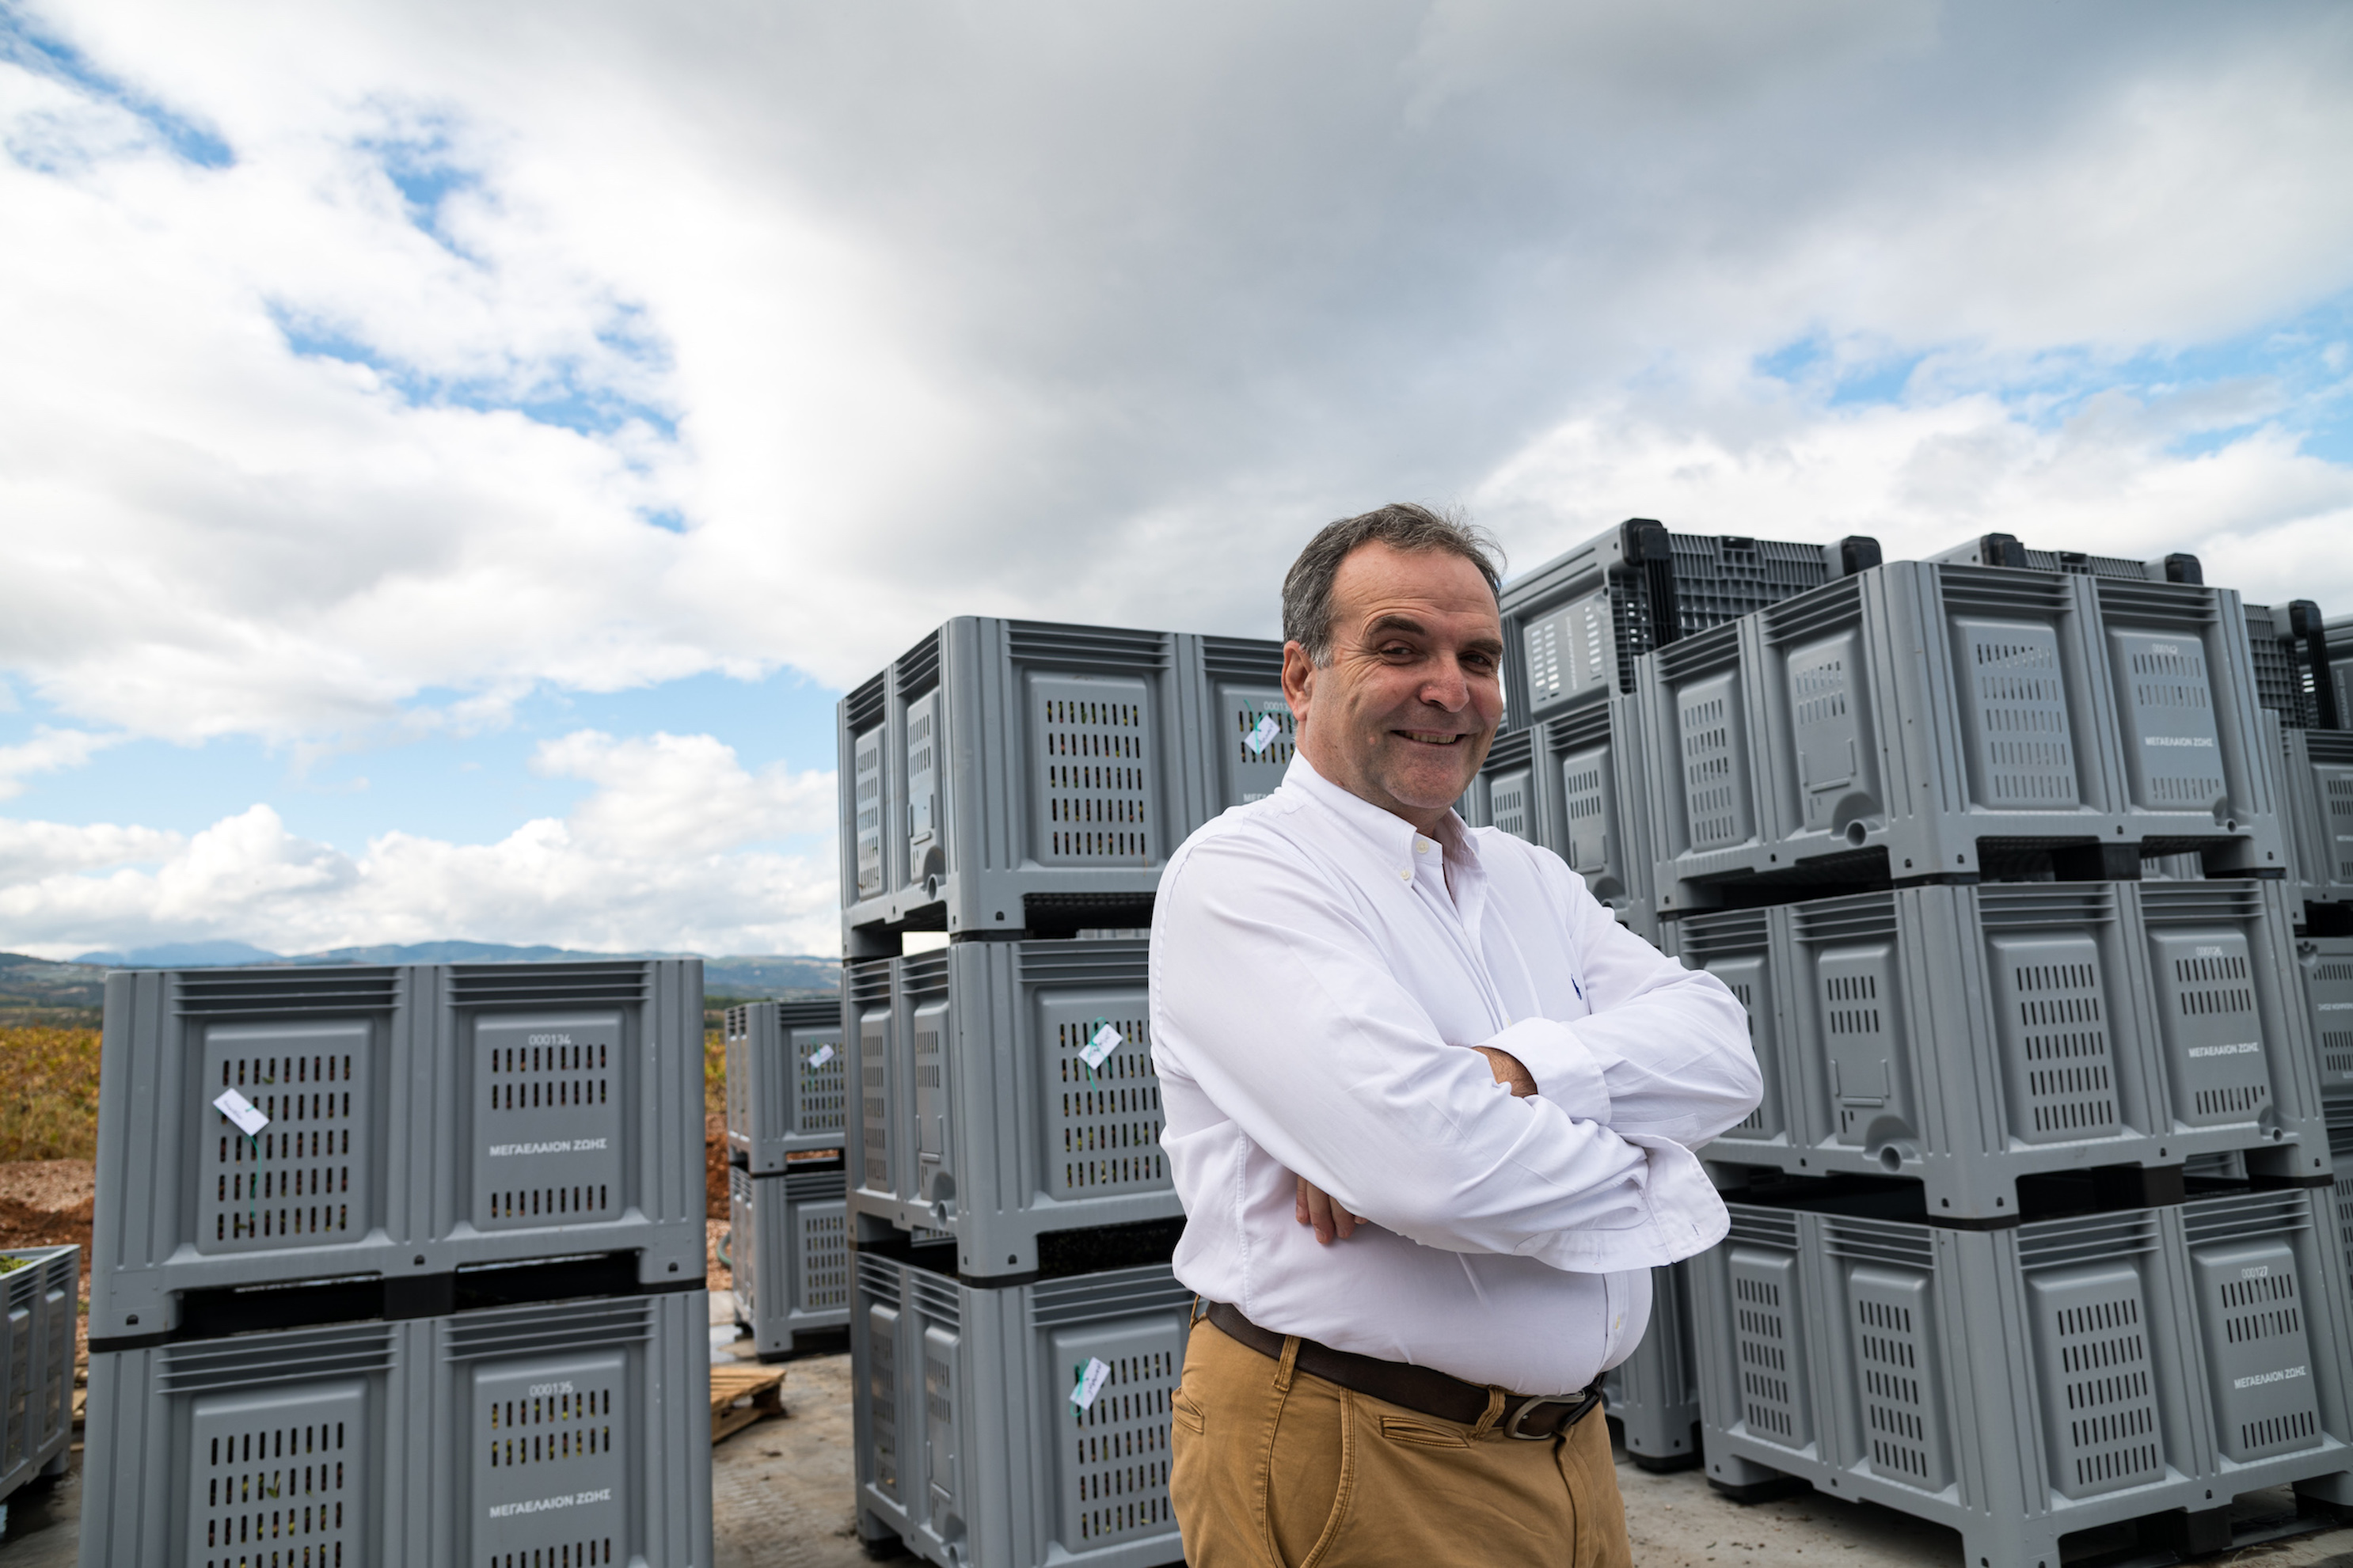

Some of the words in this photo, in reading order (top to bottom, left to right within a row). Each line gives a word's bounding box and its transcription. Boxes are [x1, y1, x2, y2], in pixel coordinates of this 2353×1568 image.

[528, 1034, 572, 1046] 000134
[2188, 1045, 2237, 1057] ΜΕΓΑΕΛΑΙΟΝ
[489, 1141, 571, 1156] ΜΕΓΑΕΛΑΙΟΝ
[573, 1137, 607, 1151] ΖΩΗΣ
[2233, 1370, 2284, 1389] ΜΕΓΑΕΛΑΙΟΝ
[2285, 1365, 2306, 1380] ΖΩΗΣ
[489, 1495, 574, 1518] ΜΕΓΑΕΛΑΙΟΝ
[576, 1487, 611, 1505] ΖΩΗΣ
